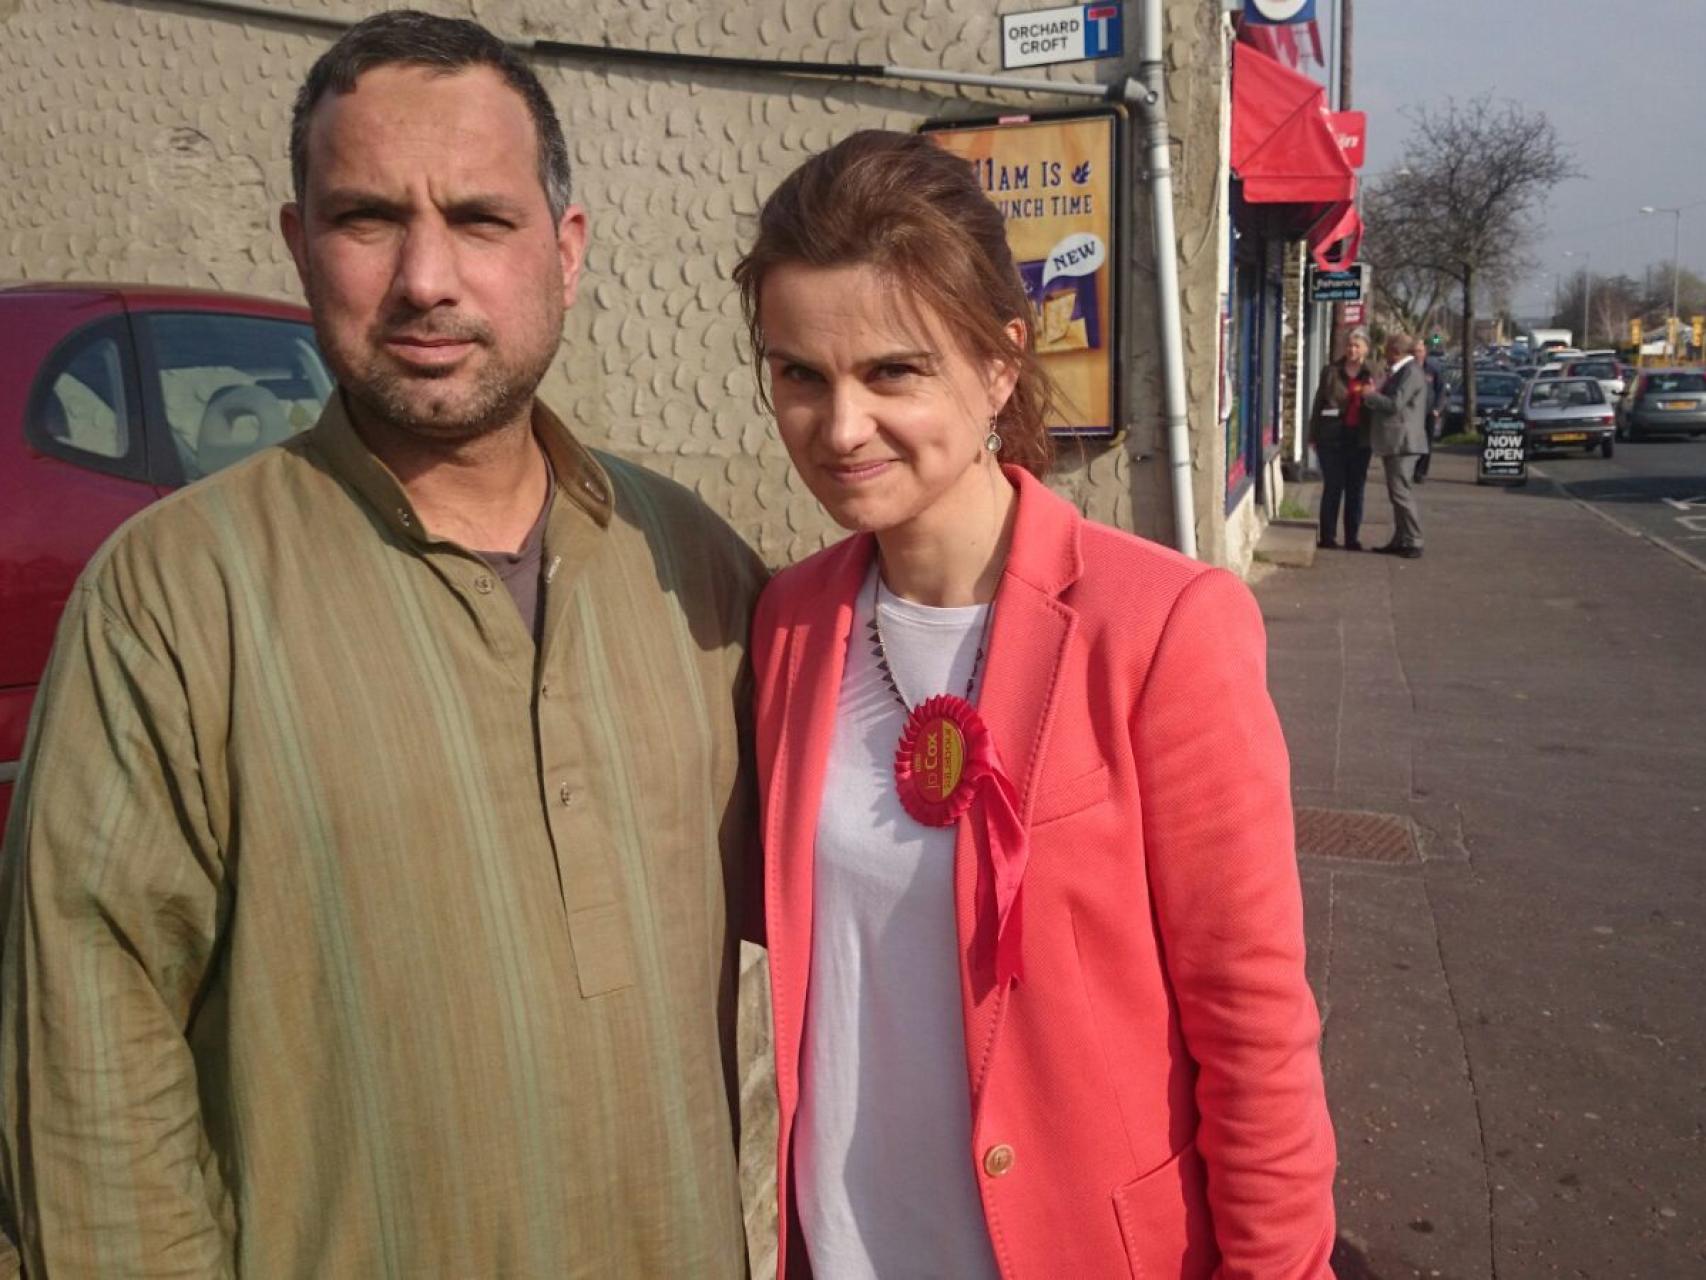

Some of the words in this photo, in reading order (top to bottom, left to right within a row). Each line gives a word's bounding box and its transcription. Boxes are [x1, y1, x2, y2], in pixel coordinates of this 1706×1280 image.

[1008, 20, 1080, 40] ORCHARD
[1020, 37, 1067, 54] CROFT
[1041, 161, 1061, 187] IS
[1000, 199, 1044, 218] UNCH
[1051, 194, 1092, 216] TIME
[1053, 241, 1096, 271] NEW
[1487, 435, 1523, 448] NOW
[1484, 448, 1525, 461] OPEN
[925, 731, 939, 770] Cox
